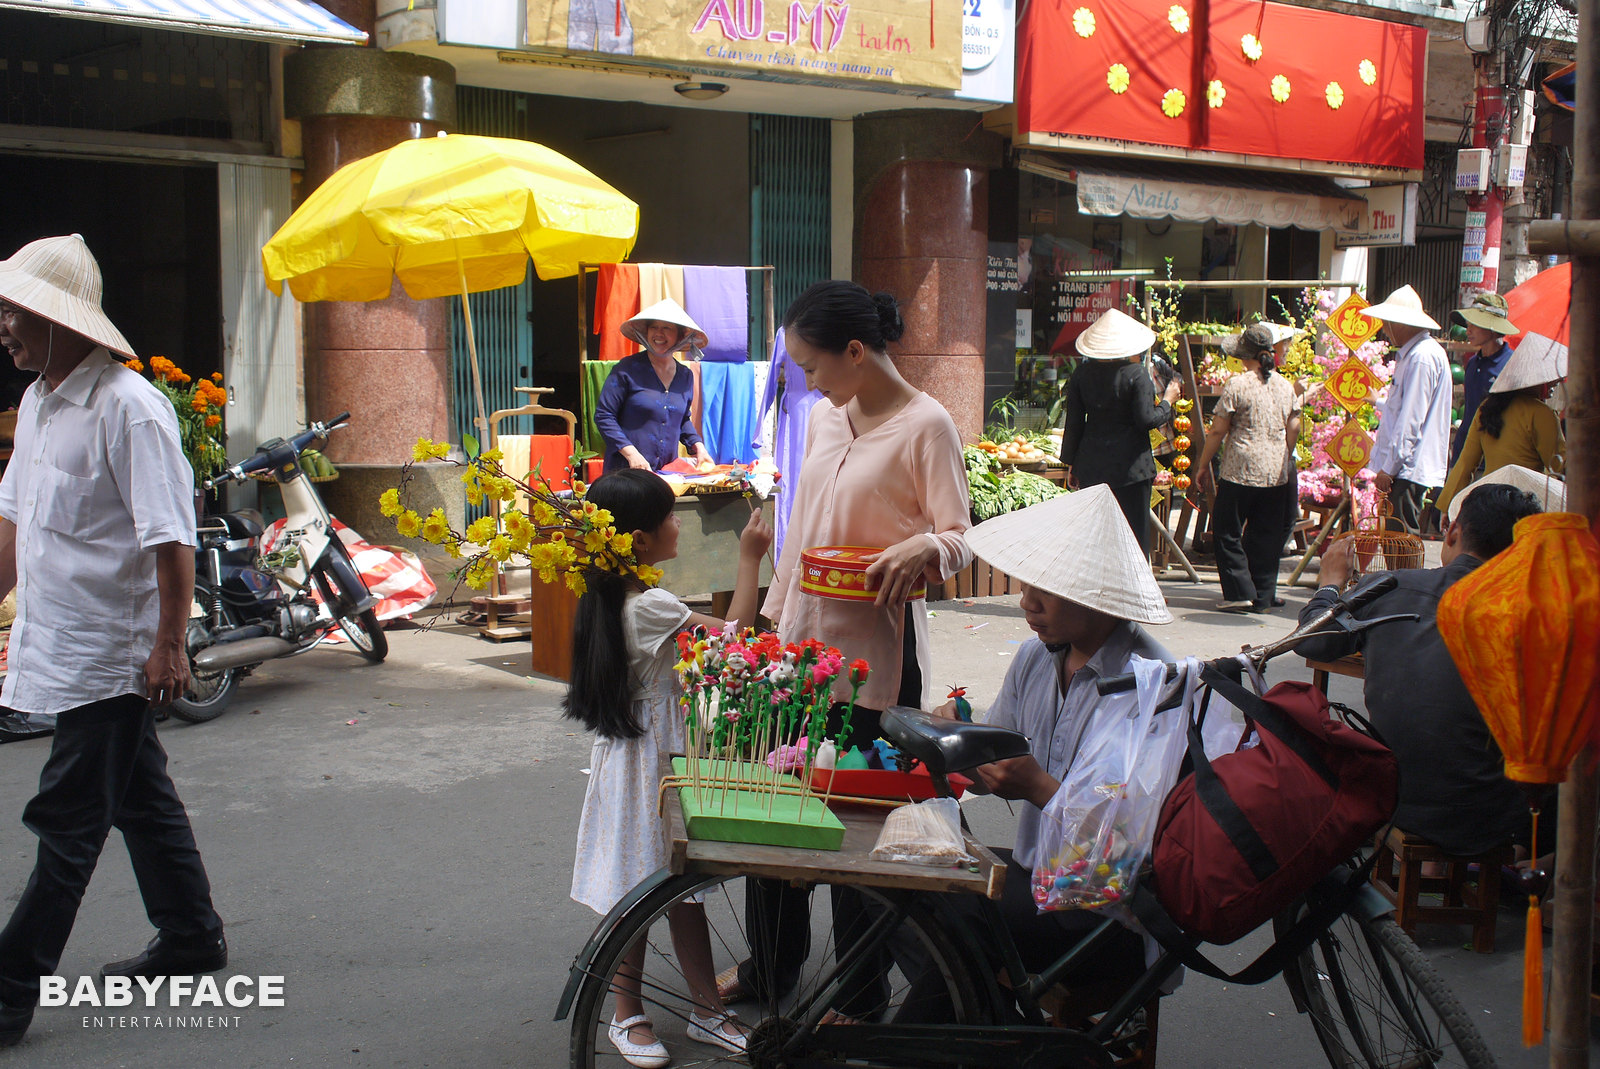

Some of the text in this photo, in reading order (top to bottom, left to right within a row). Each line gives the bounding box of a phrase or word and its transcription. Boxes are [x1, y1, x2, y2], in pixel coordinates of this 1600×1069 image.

[857, 23, 913, 54] tailor
[800, 54, 838, 73] trang
[841, 63, 872, 74] nam
[1123, 182, 1180, 211] Nails
[1372, 209, 1396, 230] Thu
[1058, 281, 1088, 293] TRANG
[1075, 294, 1090, 308] GÓT
